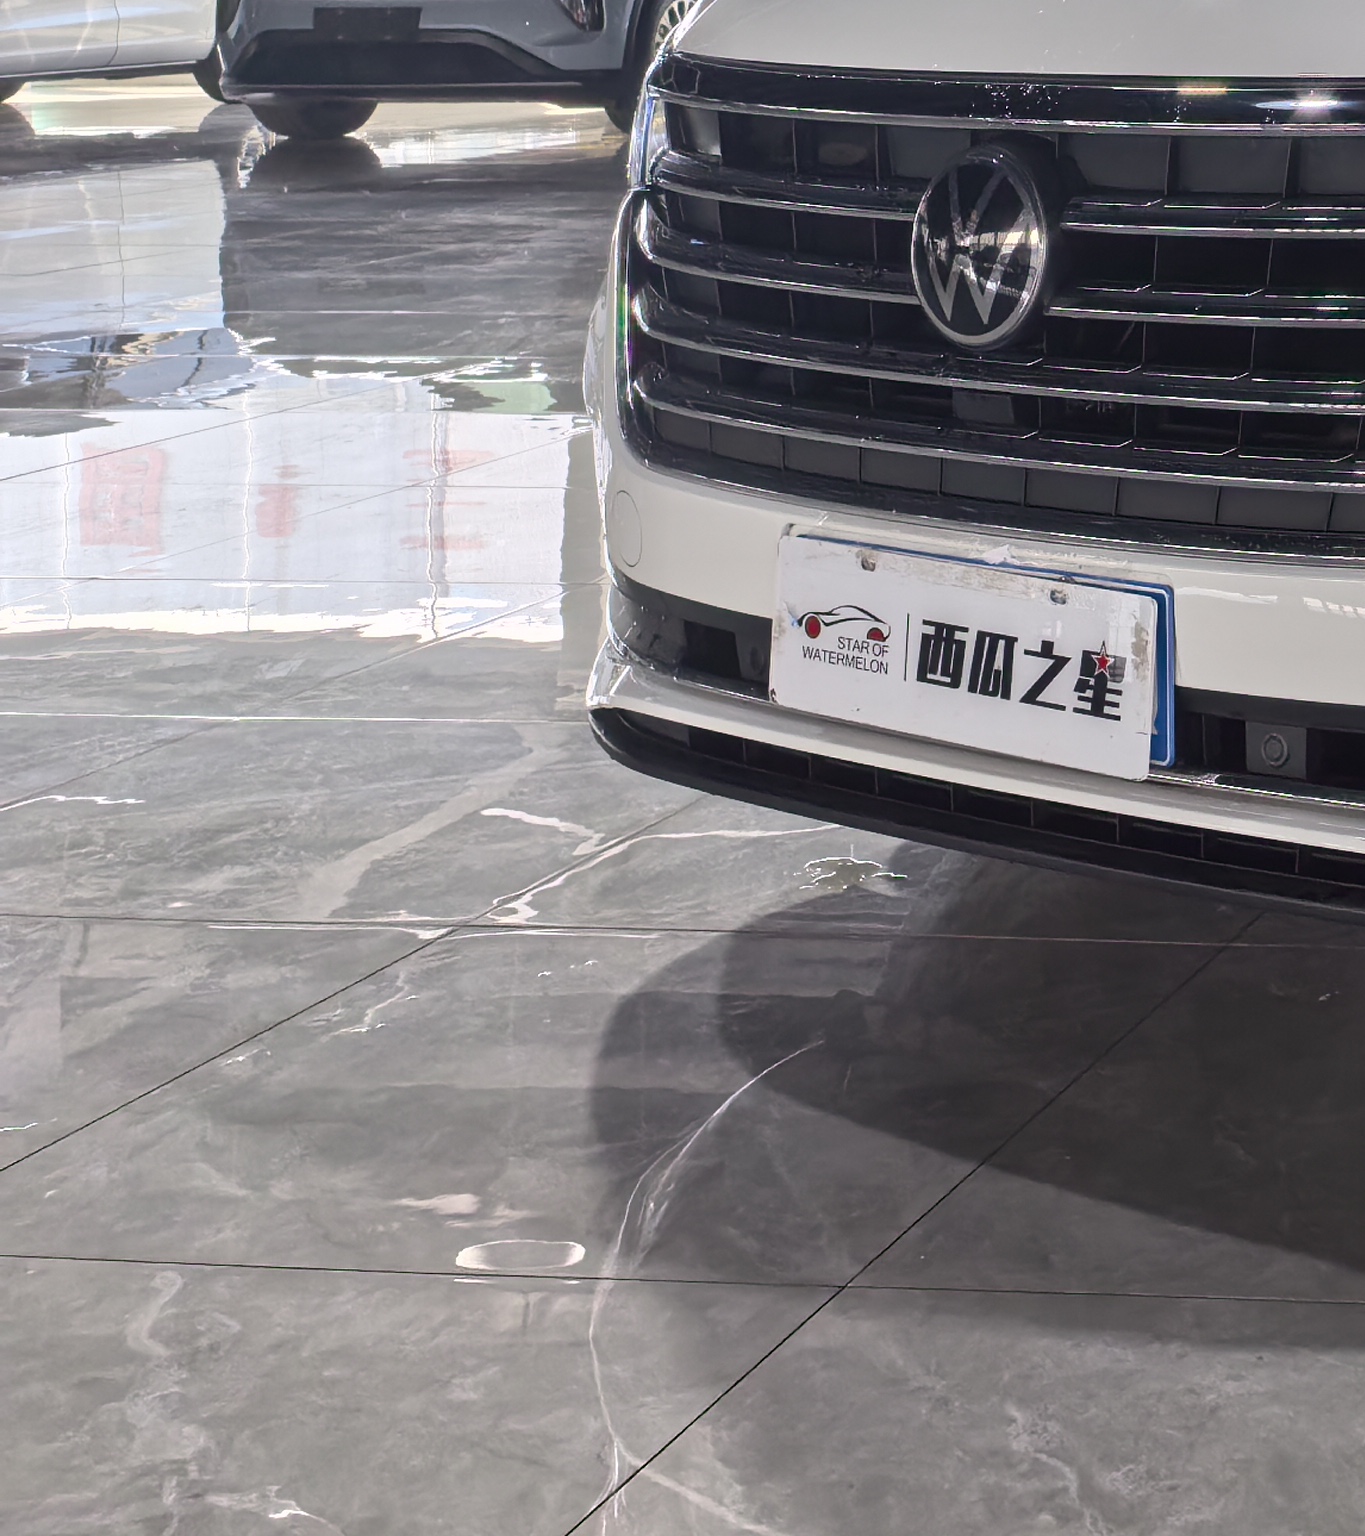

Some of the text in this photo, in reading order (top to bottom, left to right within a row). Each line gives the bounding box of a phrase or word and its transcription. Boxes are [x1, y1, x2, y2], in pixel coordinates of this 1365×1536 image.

[802, 645, 888, 675] WATERMELON
[838, 636, 889, 658] STAR OF
[916, 619, 1128, 722] 西瓜之星
